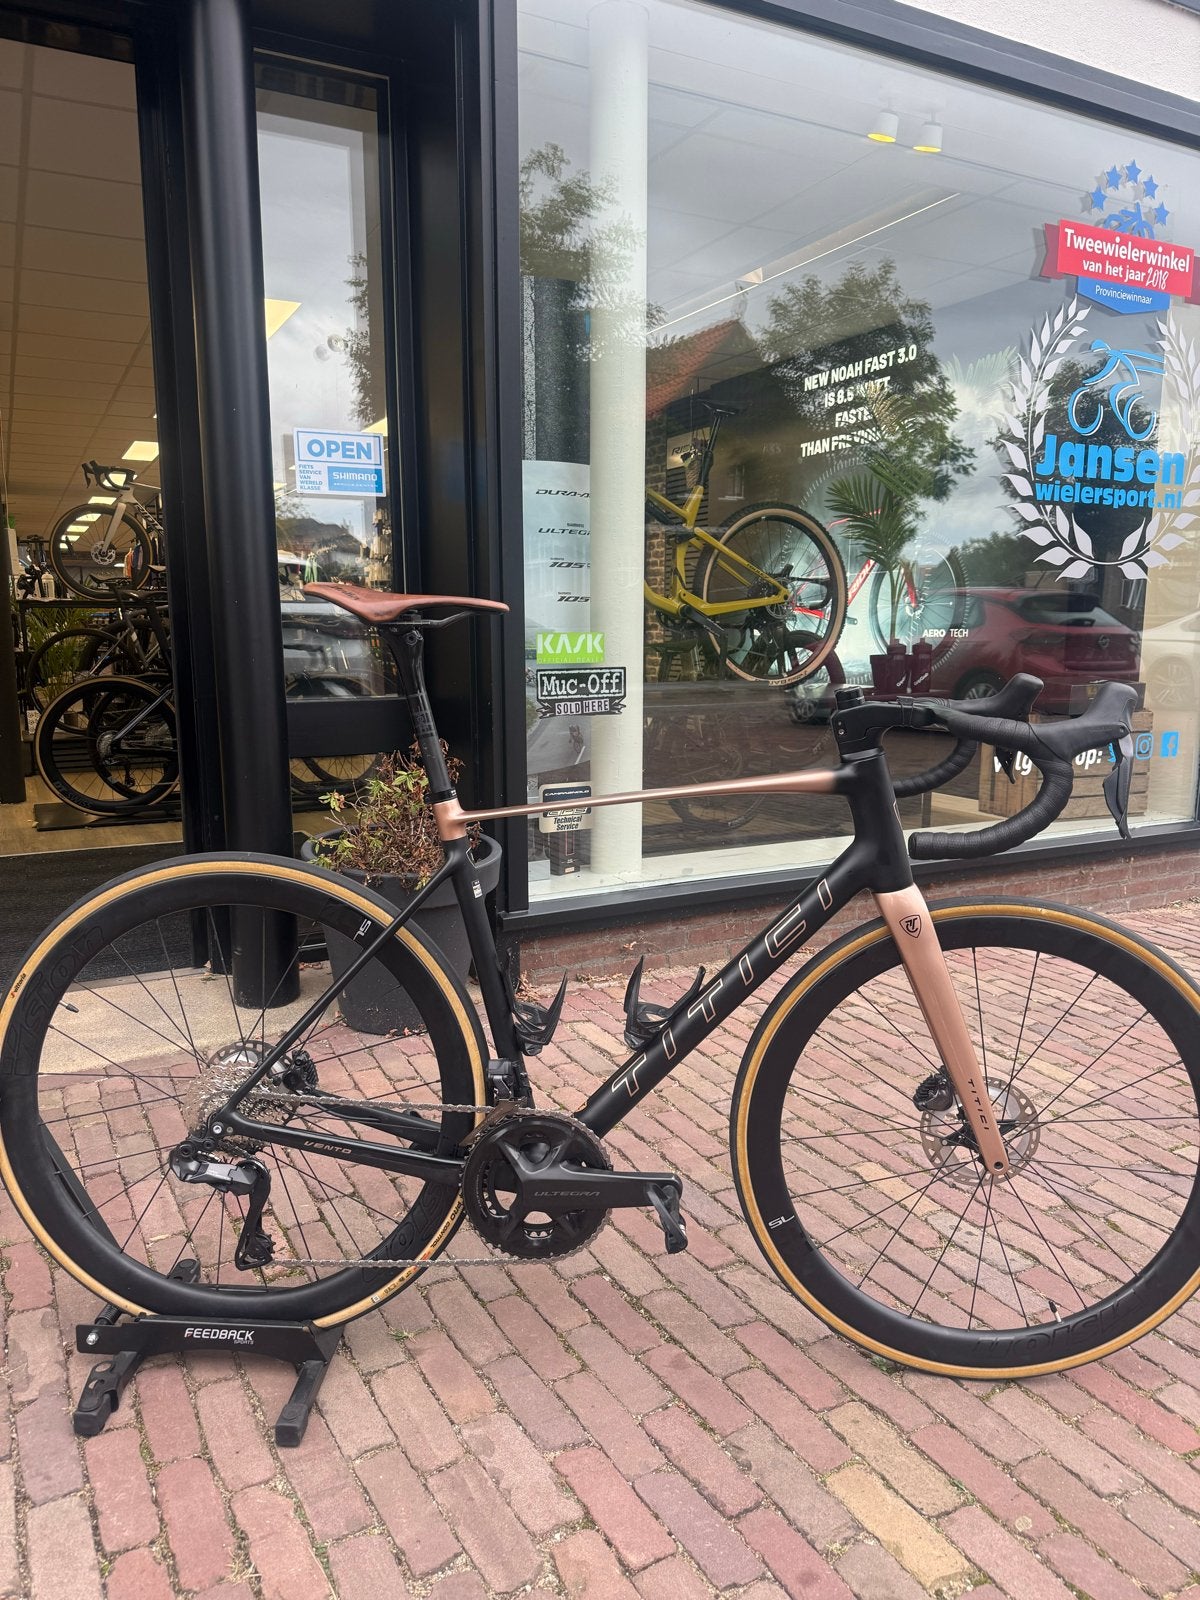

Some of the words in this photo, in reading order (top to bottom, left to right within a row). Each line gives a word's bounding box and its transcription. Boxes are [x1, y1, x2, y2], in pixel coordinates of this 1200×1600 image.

[1064, 227, 1190, 272] Tweewielerwinkel
[1082, 259, 1102, 273] van
[1105, 260, 1123, 277] het
[1124, 264, 1146, 282] jaar
[1145, 266, 1169, 290] 2018
[1095, 284, 1153, 304] Provinciewinnaar
[804, 370, 830, 391] NEW
[830, 360, 863, 384] NOAH
[864, 350, 896, 374] FAST
[897, 344, 917, 364] 3.0
[824, 391, 836, 408] IS
[306, 438, 373, 460] OPEN
[800, 437, 831, 458] THAN
[1035, 434, 1185, 486] Jansen
[332, 471, 378, 481] SHIMANO
[535, 489, 590, 498] DURA-A
[1035, 480, 1183, 510] wielersport.nl
[538, 527, 590, 536] ULTEG
[922, 629, 946, 638] AERO
[949, 628, 969, 637] TECH
[537, 633, 604, 654] KASK
[542, 672, 621, 695] Muc-Off
[555, 702, 580, 715] SOLD
[584, 700, 609, 713] HERE
[553, 815, 583, 825] Technical
[556, 822, 579, 831] Service
[610, 878, 833, 1098] TITICI
[967, 1078, 990, 1130] TITICI
[303, 1140, 352, 1154] VENTO
[768, 1214, 796, 1230] SL
[184, 1327, 256, 1341] FEEDBACK
